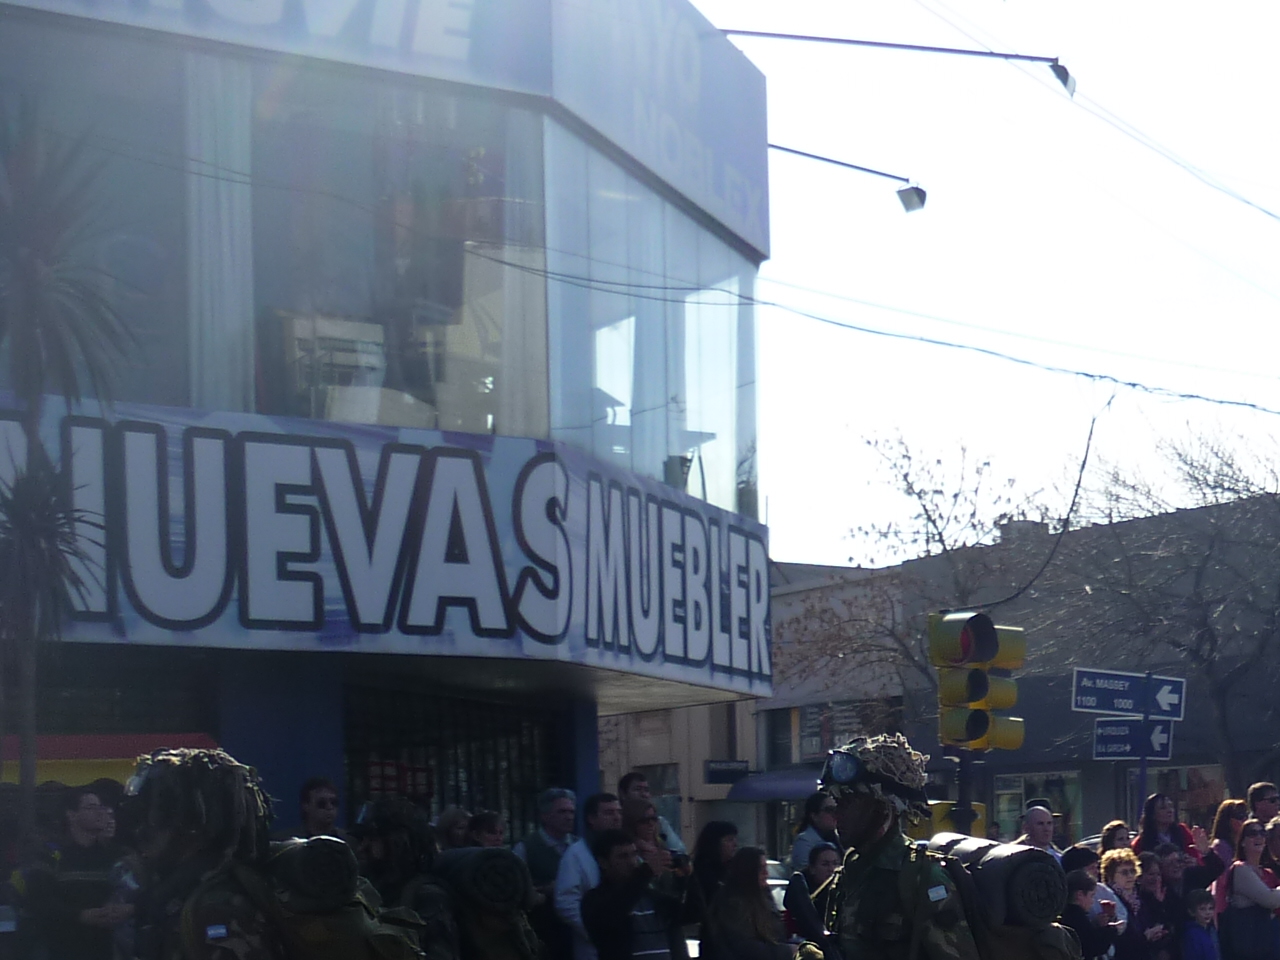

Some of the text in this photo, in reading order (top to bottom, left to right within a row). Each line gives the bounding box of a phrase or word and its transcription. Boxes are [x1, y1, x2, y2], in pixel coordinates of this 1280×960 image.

[1096, 679, 1130, 690] MASSEY
[1077, 696, 1133, 709] 1100 1000
